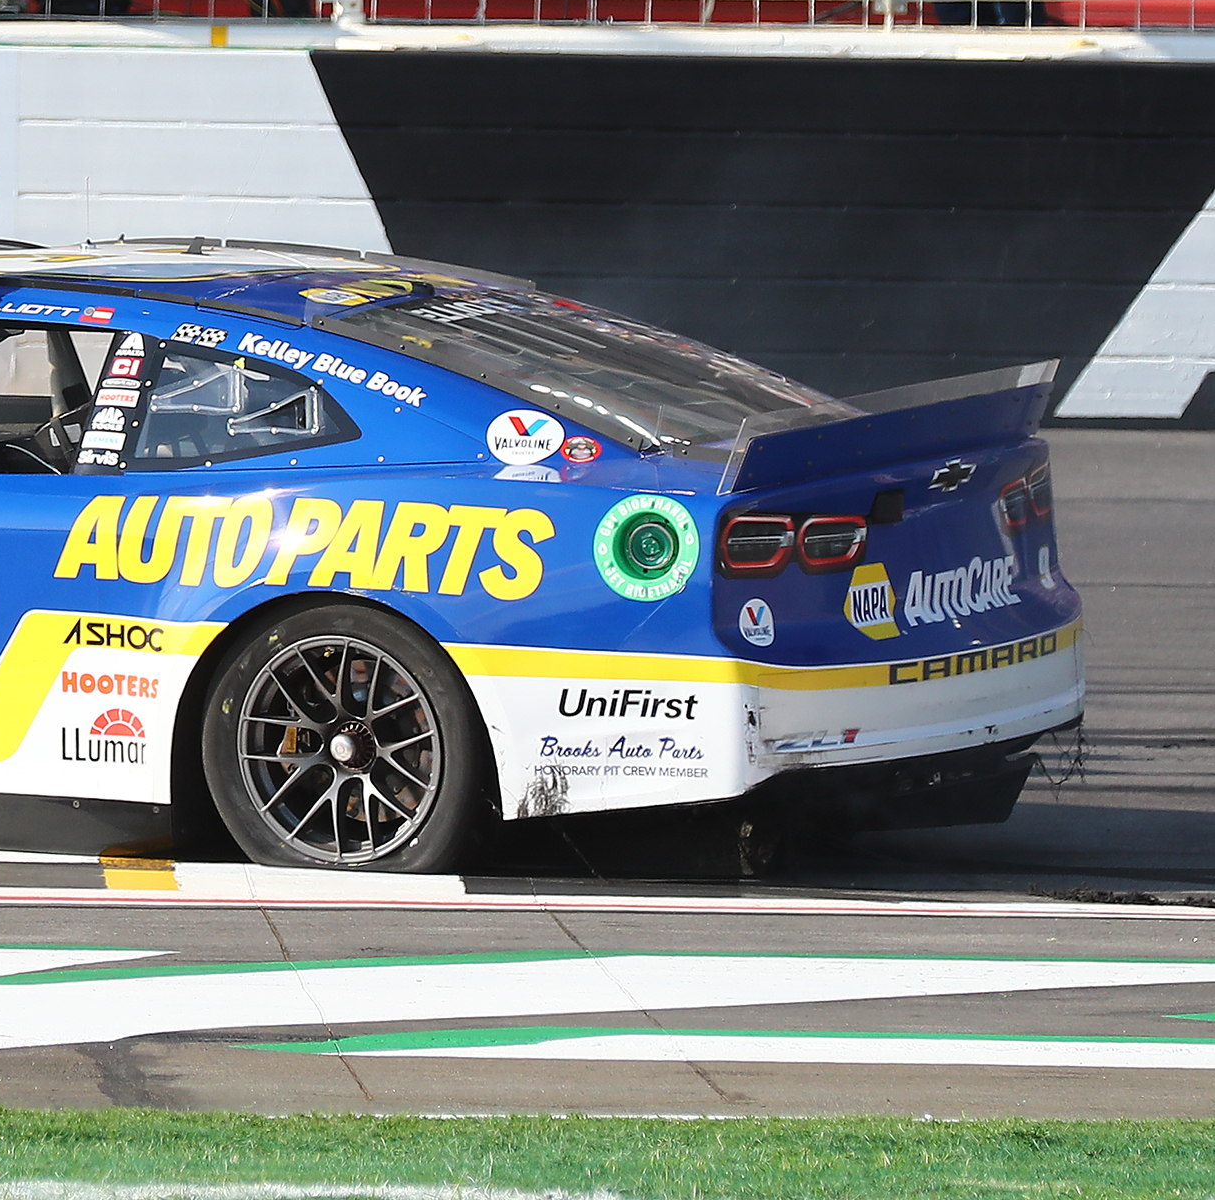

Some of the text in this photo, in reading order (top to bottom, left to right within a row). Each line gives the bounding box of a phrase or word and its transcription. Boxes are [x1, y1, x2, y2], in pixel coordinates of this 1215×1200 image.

[237, 332, 427, 408] Kelley Blue Book
[99, 394, 135, 403] HOOTERS
[494, 436, 553, 452] VALVOLINE
[599, 496, 690, 537] GET BIOETHANOL
[604, 566, 626, 589] GET
[1038, 545, 1056, 590] 9
[851, 584, 890, 624] NAPA
[888, 633, 1058, 686] CAMARO
[61, 671, 160, 699] HOOTERS
[558, 688, 699, 721] UniFirst
[61, 727, 147, 765] LLumar
[539, 735, 705, 761] Brooks Auto Parts
[775, 728, 860, 751] ZL1
[534, 765, 709, 778] HONORARY PIT CREW MEMBER
